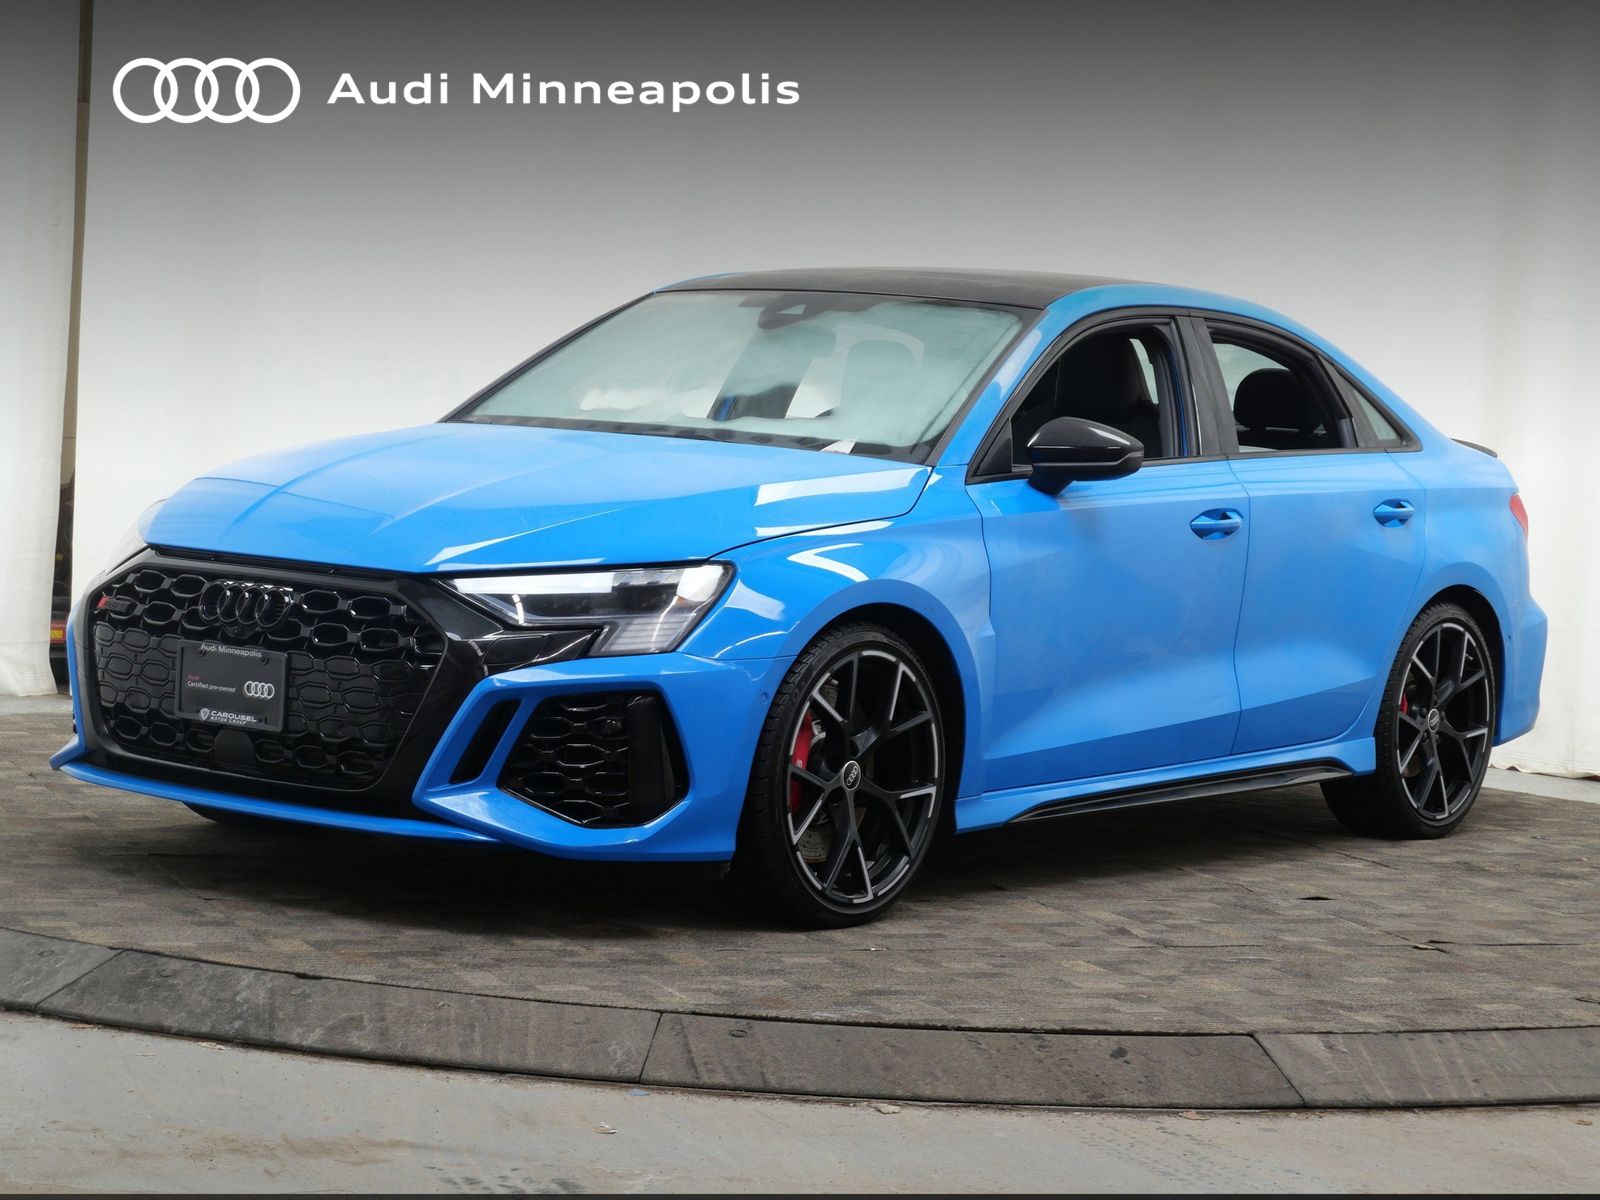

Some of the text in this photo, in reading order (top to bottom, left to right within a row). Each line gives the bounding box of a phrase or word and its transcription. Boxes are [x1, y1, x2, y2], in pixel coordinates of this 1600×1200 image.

[200, 643, 262, 657] Audi Minneapolis
[187, 680, 208, 689] Certified
[211, 710, 257, 722] CAROUSEL
